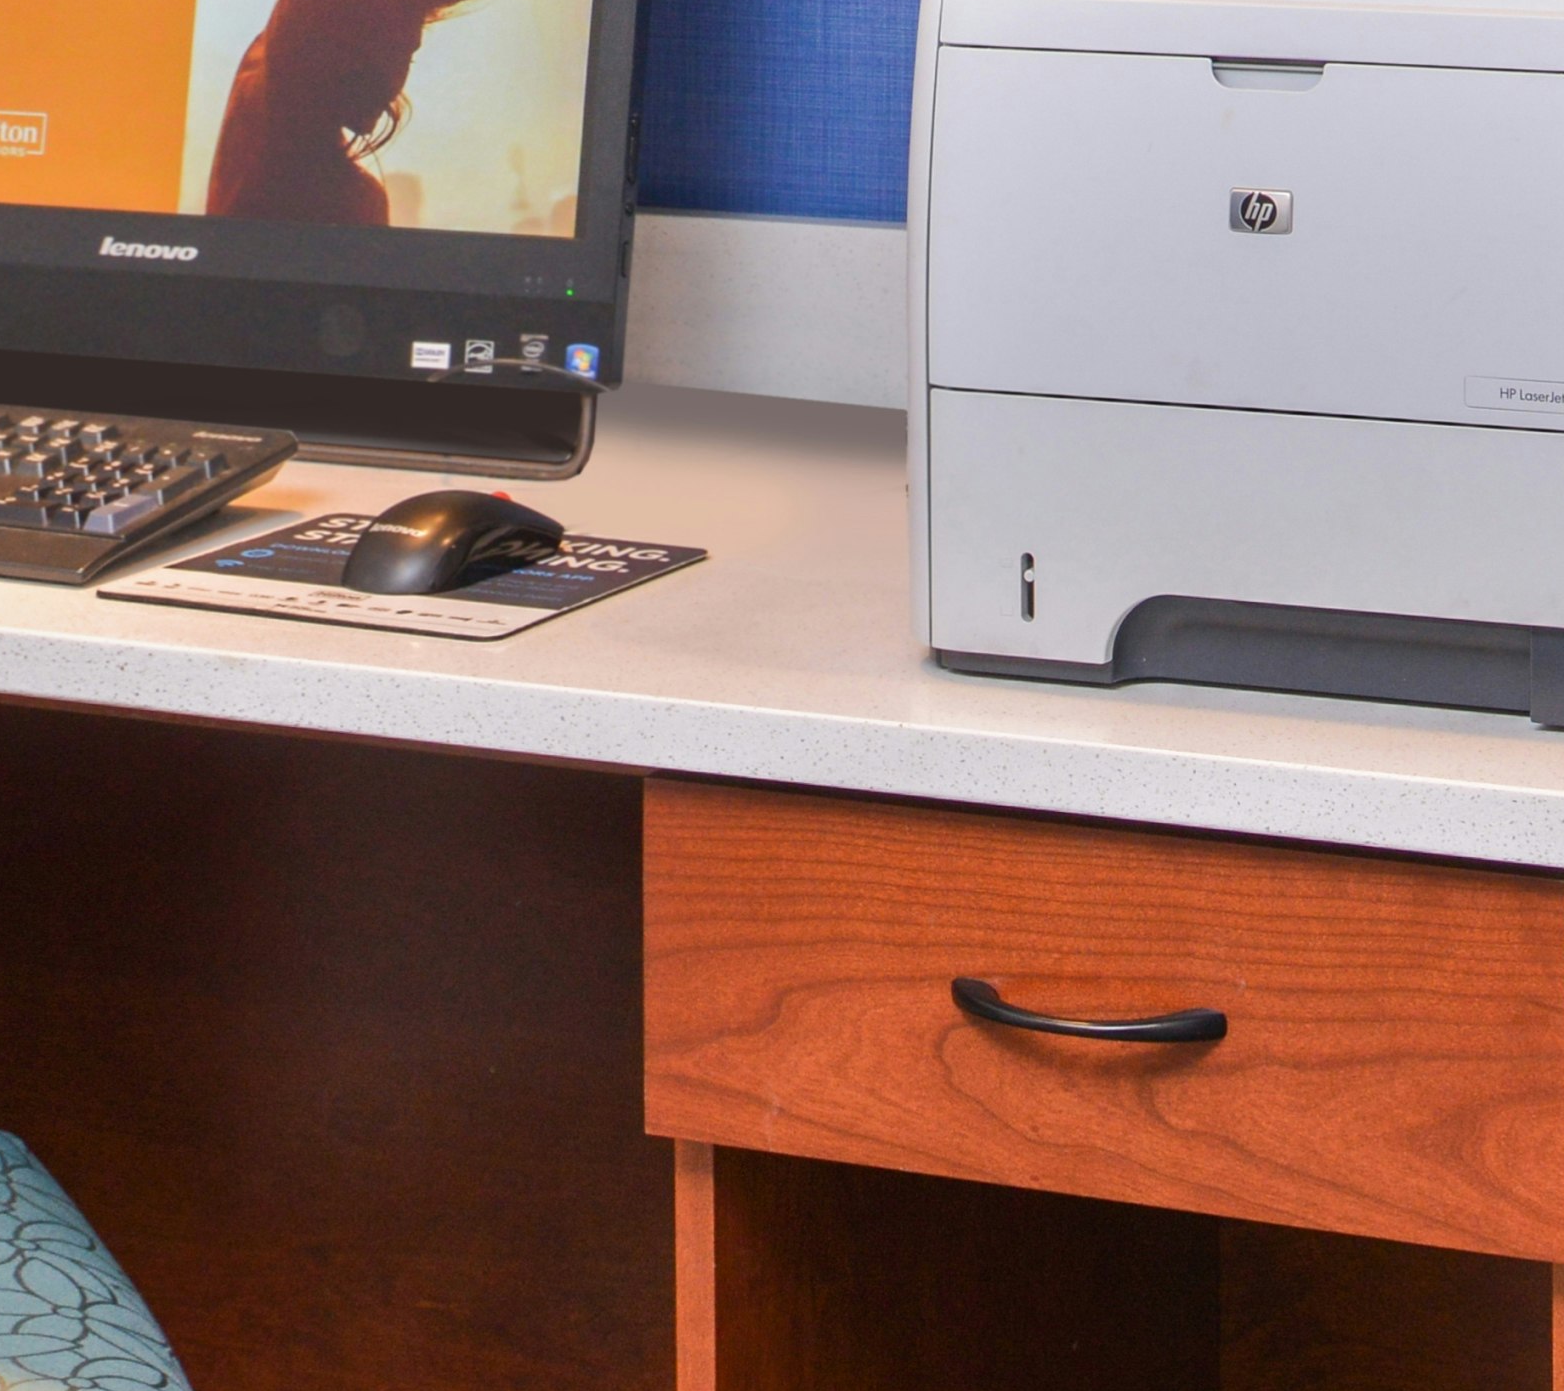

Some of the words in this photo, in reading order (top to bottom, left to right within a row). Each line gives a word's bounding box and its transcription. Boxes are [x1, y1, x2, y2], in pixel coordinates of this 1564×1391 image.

[1243, 190, 1274, 232] hp
[99, 236, 199, 262] lenovo
[1499, 387, 1517, 400] HP
